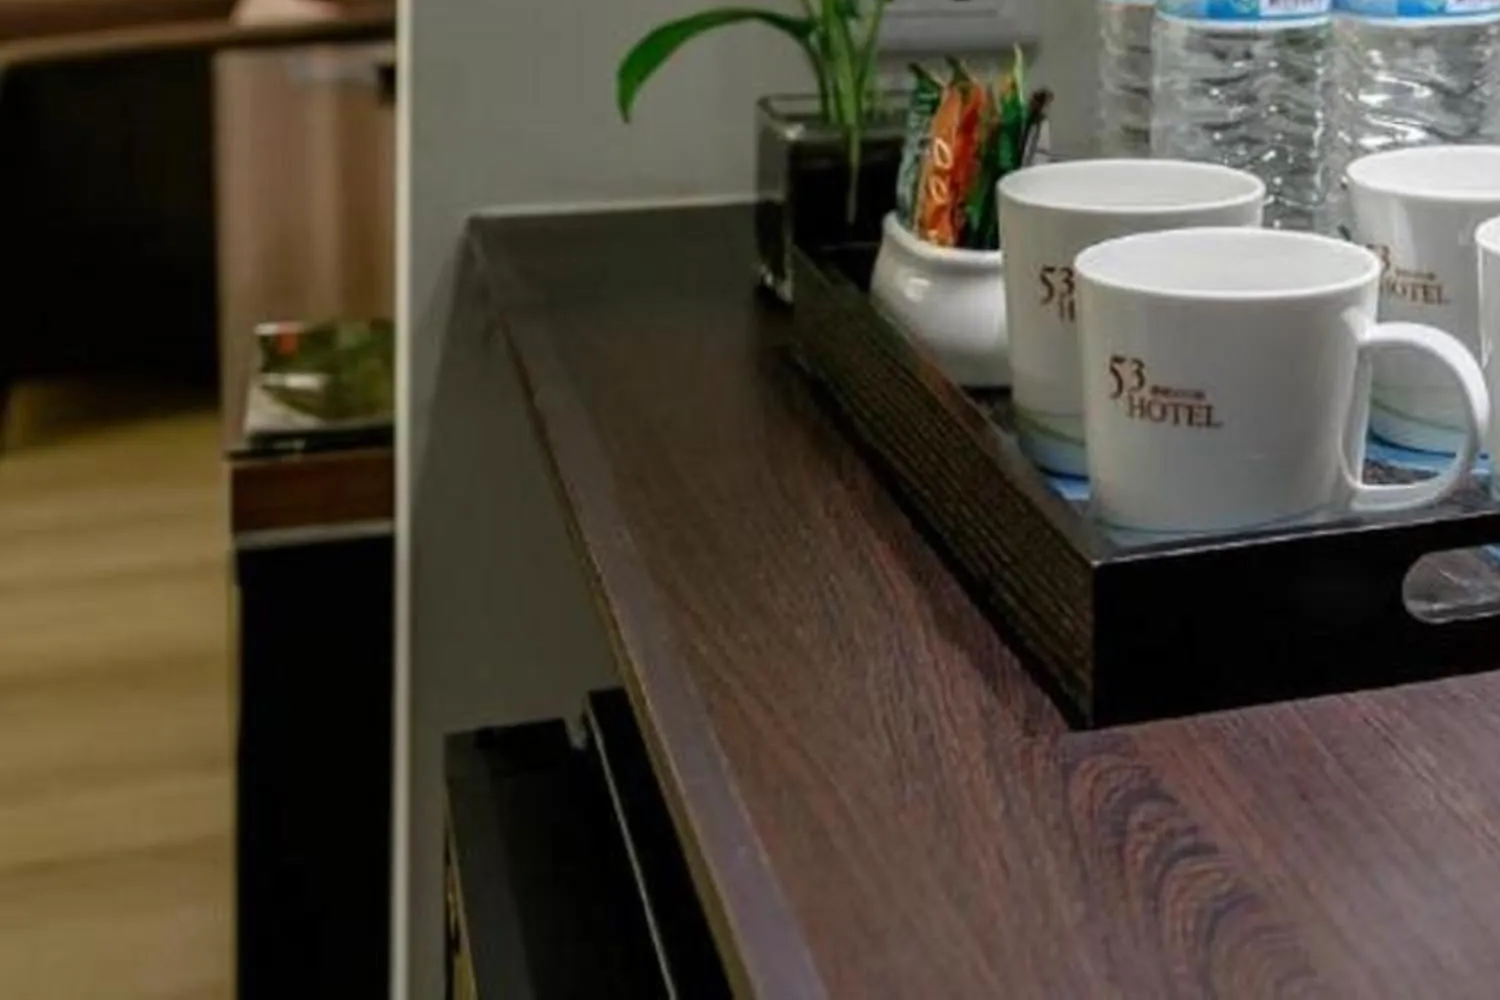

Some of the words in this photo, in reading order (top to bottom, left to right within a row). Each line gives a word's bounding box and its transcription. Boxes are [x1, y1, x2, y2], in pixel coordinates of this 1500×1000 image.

[1040, 266, 1075, 305] 53
[1109, 355, 1145, 399] 53
[1126, 394, 1225, 428] HOTEL
